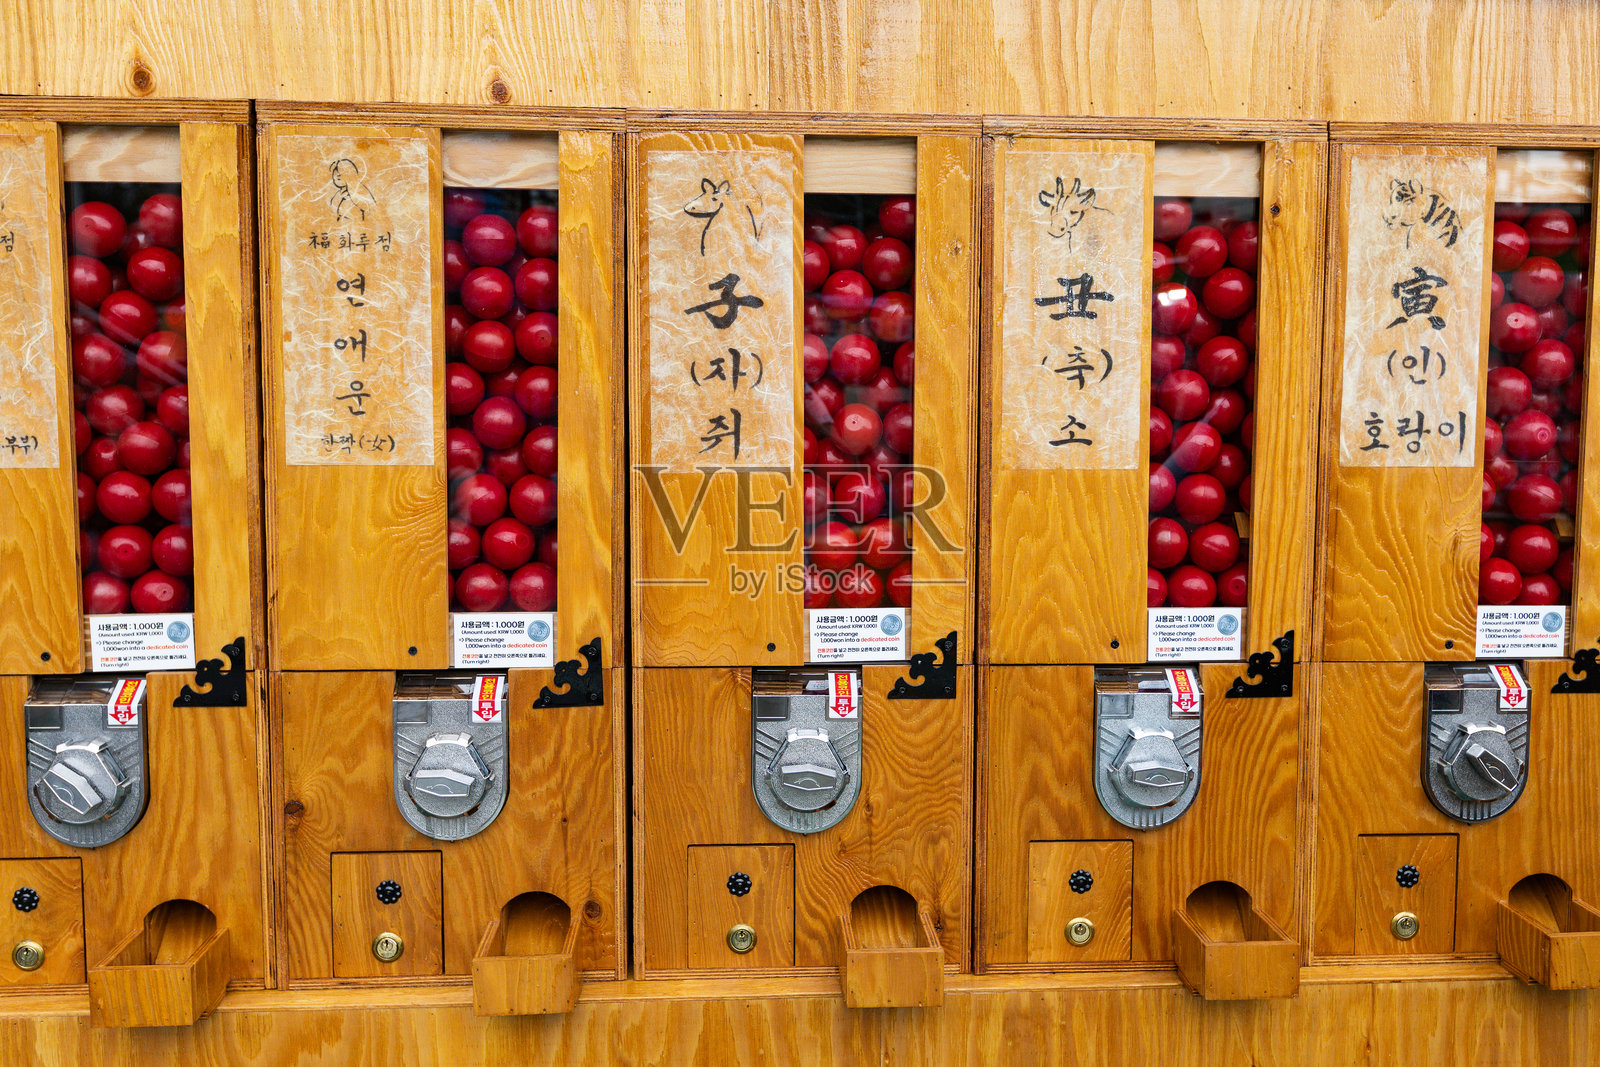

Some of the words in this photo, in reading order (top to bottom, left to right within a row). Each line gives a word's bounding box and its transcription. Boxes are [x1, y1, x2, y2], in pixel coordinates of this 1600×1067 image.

[684, 273, 764, 329] 子
[1034, 273, 1114, 321] 丑
[1385, 266, 1448, 331] 寅
[691, 348, 763, 392] (자)
[1042, 346, 1113, 391] (축)
[1387, 346, 1446, 385] (인)
[699, 408, 742, 461] 쥐
[1049, 415, 1092, 447] 소
[1360, 410, 1466, 454] 호랑이
[116, 705, 129, 722] 투입
[481, 702, 493, 718] 투입
[837, 698, 849, 714] 투입
[1180, 693, 1191, 709] 투입
[1508, 688, 1519, 704] 투입
